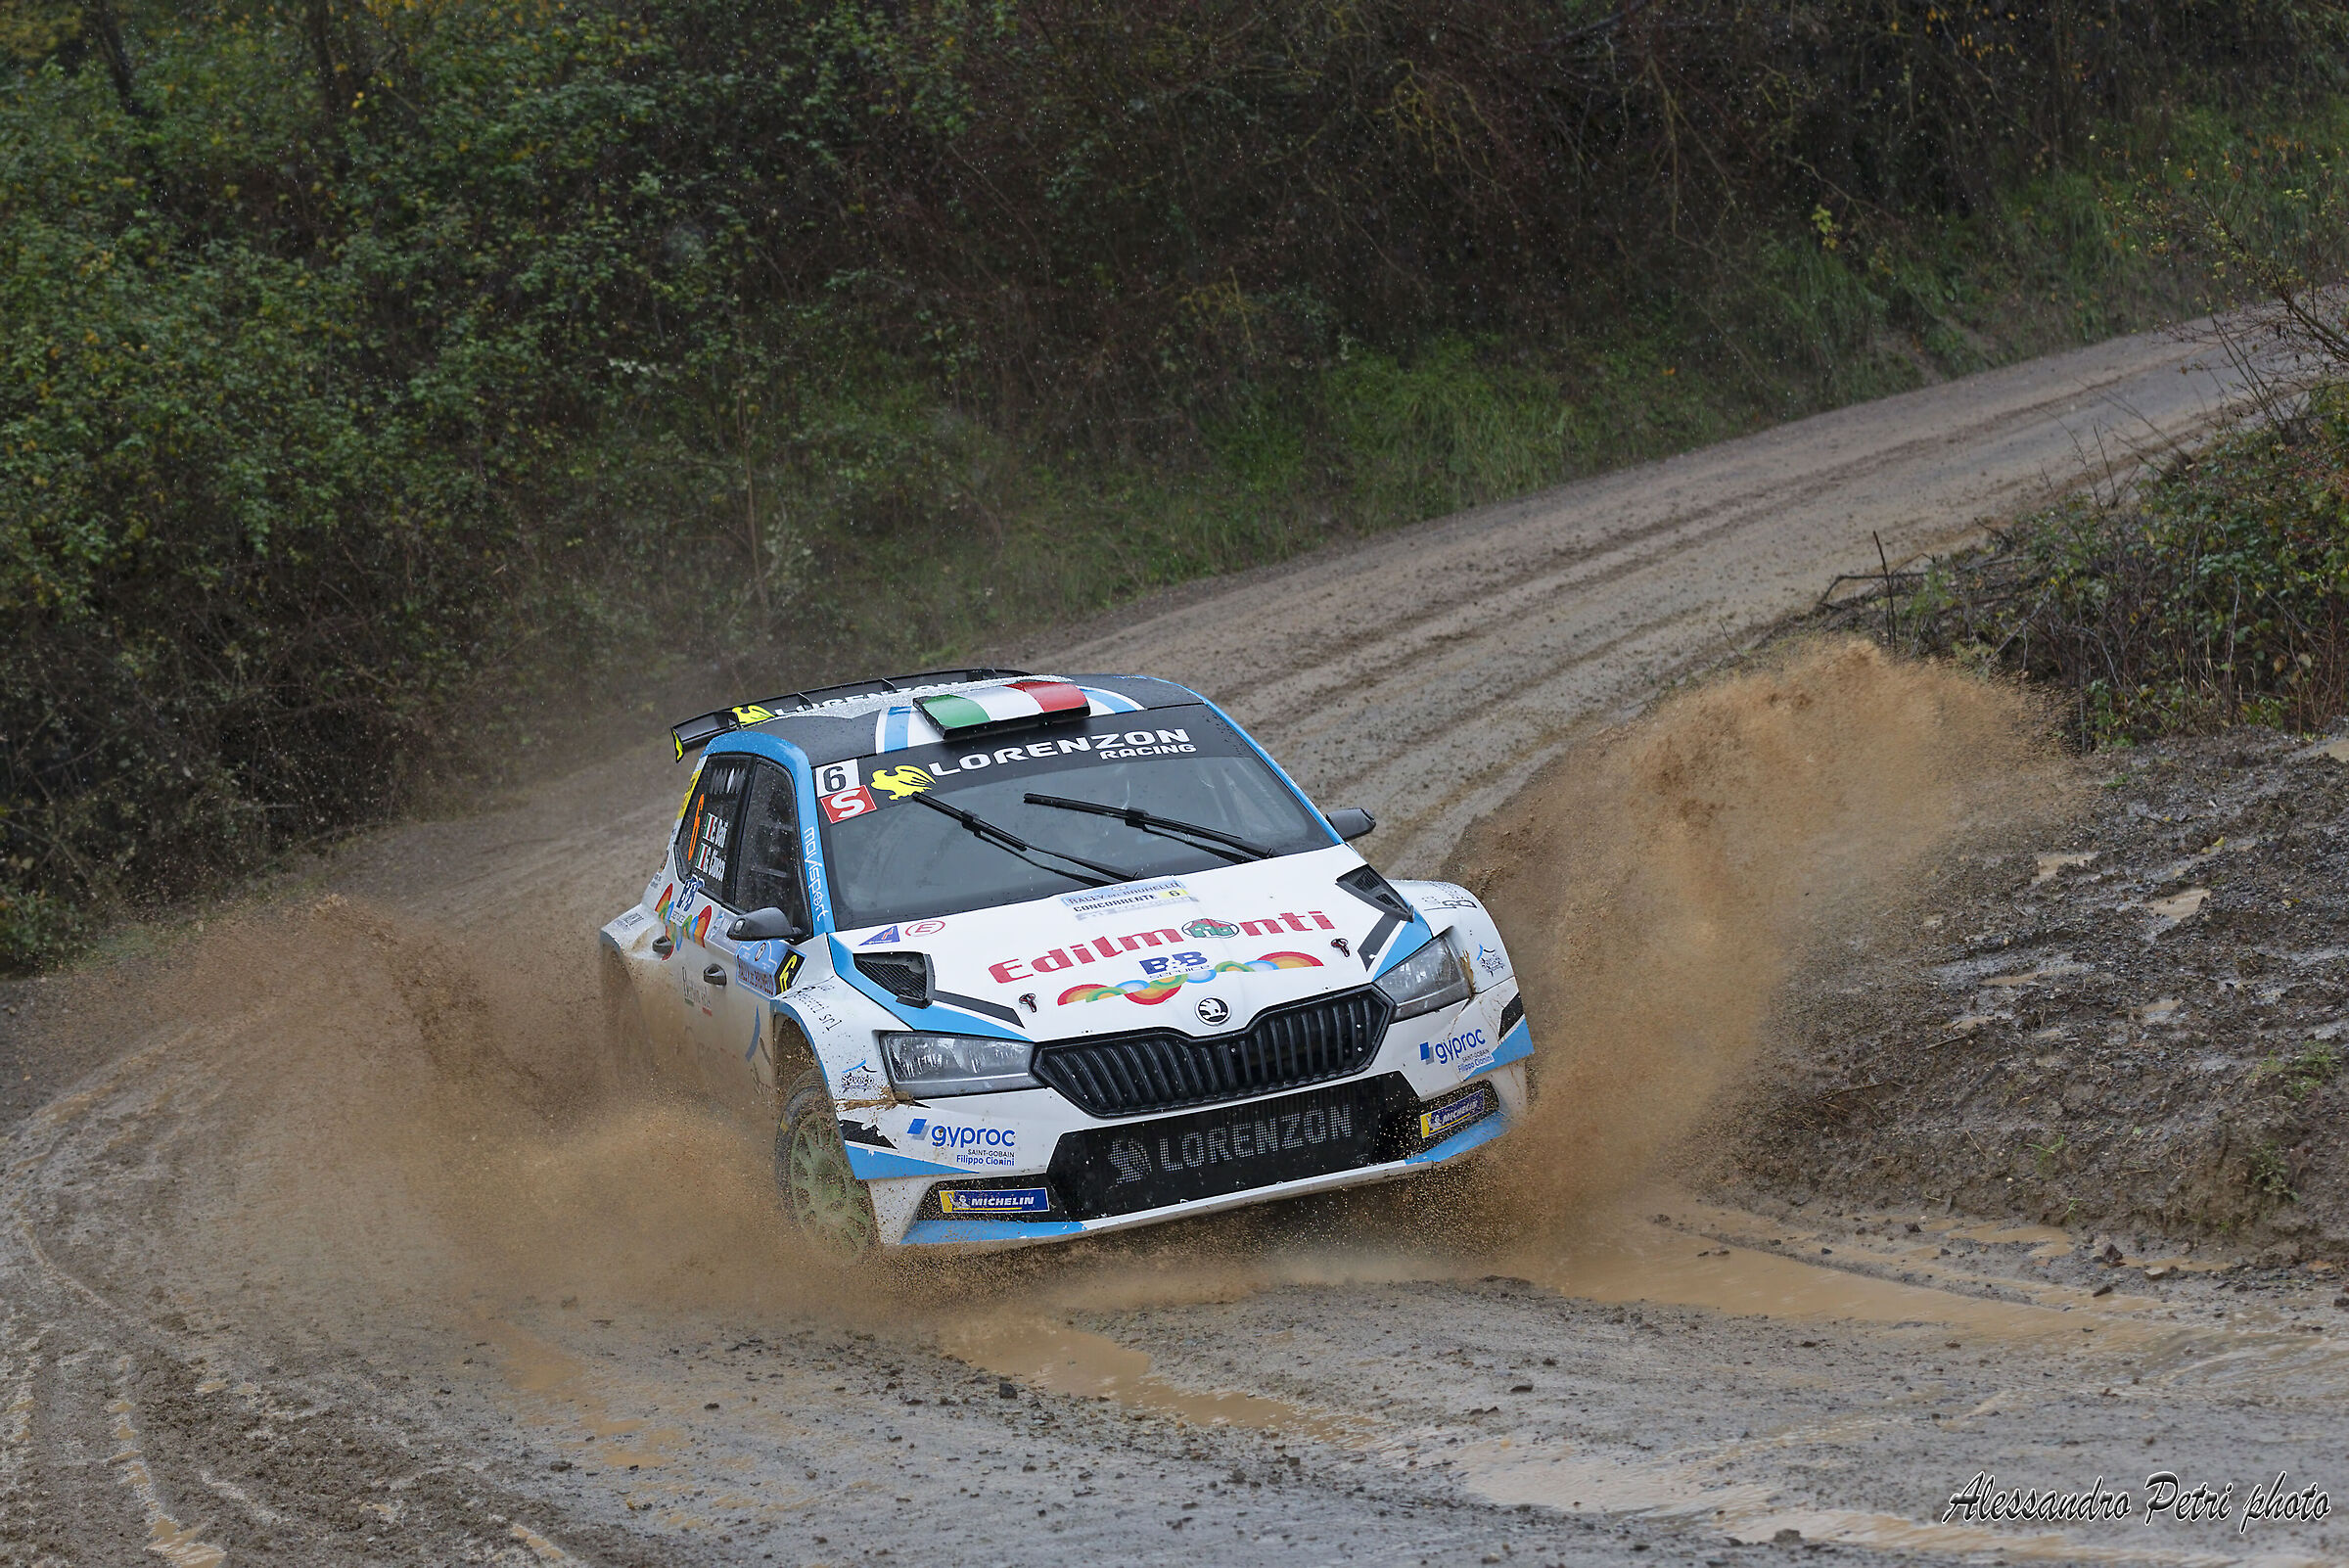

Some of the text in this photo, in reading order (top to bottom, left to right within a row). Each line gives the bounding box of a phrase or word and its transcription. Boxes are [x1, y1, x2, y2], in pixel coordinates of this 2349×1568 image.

[929, 728, 1191, 776] LORENZON
[1099, 743, 1197, 760] RACING
[822, 765, 847, 793] 6
[1073, 894, 1158, 912] CONCORRENTE
[1435, 1029, 1486, 1064] gyproc
[931, 1126, 1016, 1148] gyproc
[1159, 1103, 1352, 1172] LORENZON
[956, 1154, 984, 1166] Filippo
[971, 1196, 1035, 1207] MICHELIN
